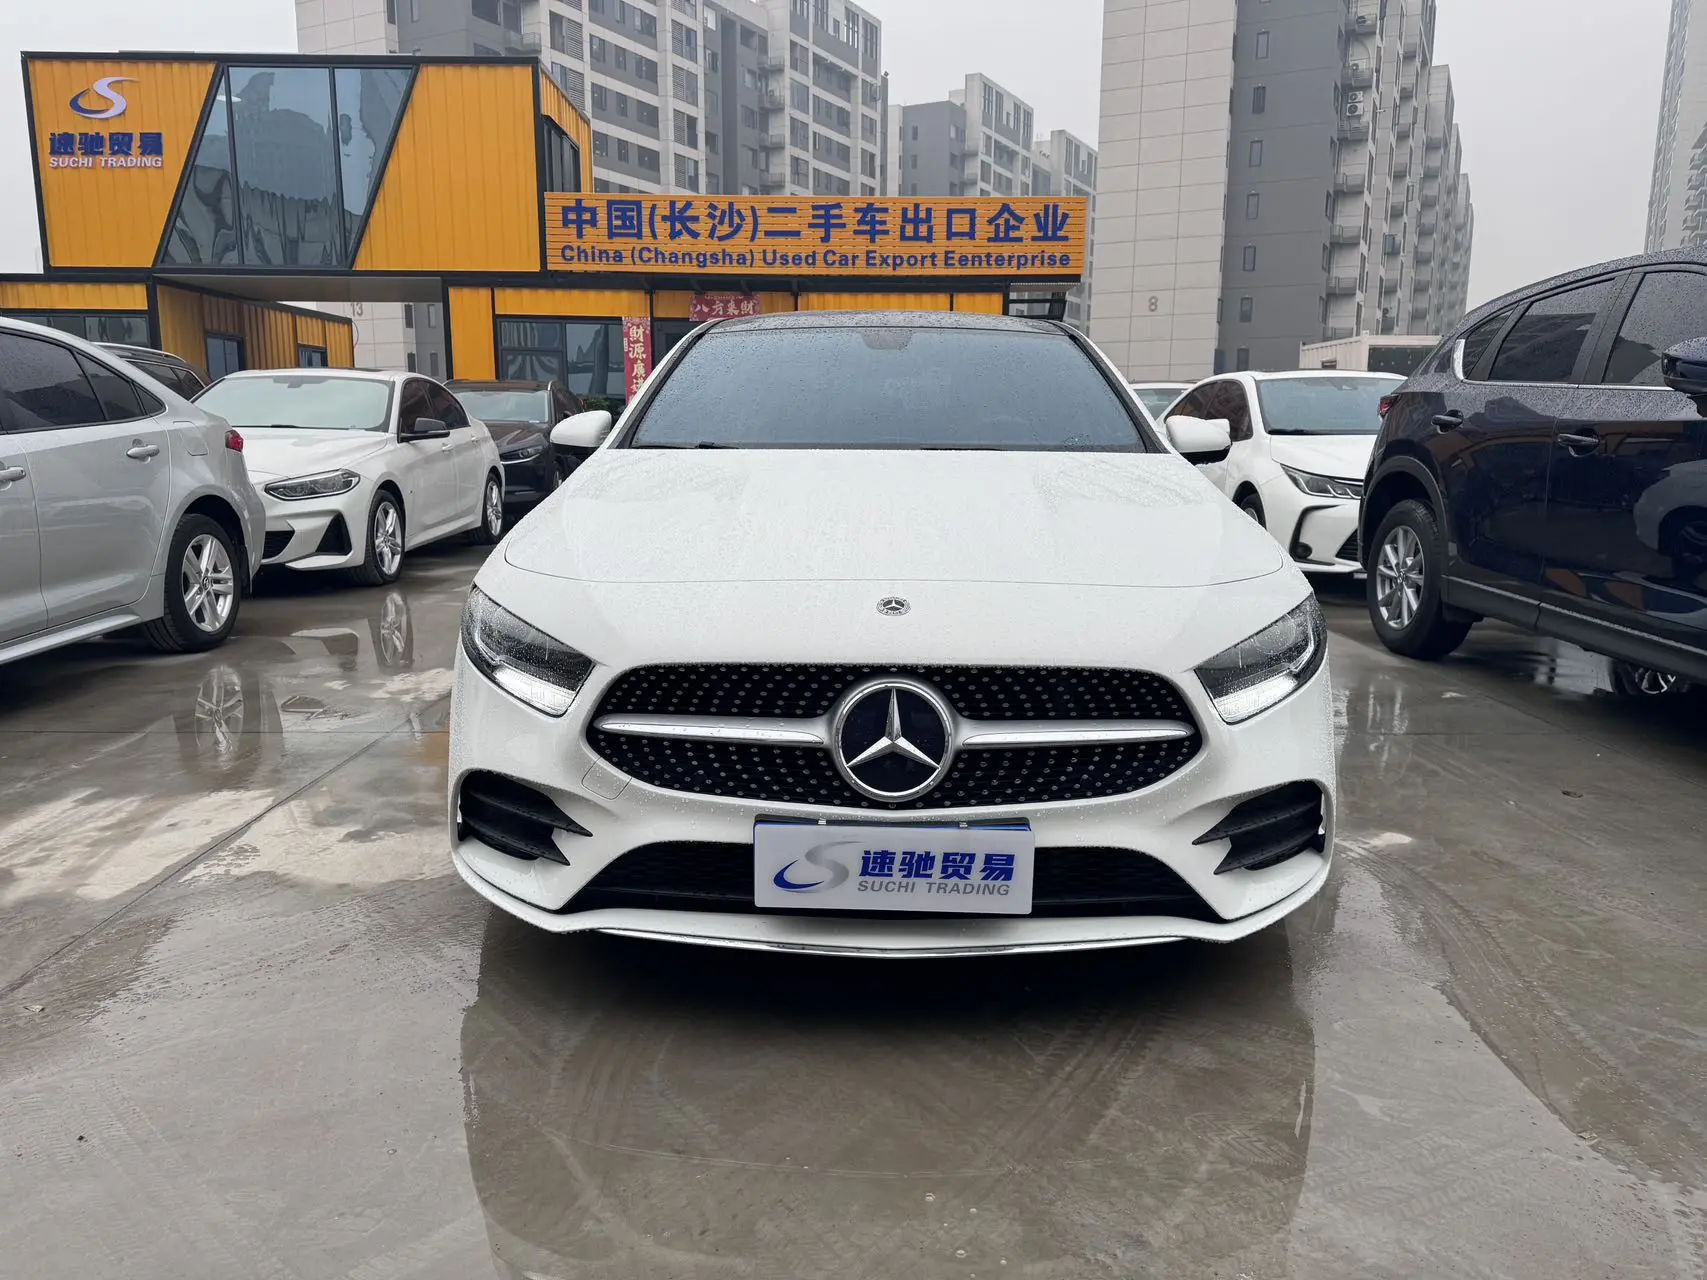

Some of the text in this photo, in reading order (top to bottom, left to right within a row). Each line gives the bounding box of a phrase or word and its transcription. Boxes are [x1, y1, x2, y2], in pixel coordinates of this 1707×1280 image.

[49, 132, 163, 155] 速驰贸易
[49, 157, 162, 168] SUCHI TRADING
[561, 198, 1070, 243] 中国(长沙)二手车出口企业
[561, 245, 1071, 271] China (Changsha) Used Car Export Eenterprise
[1148, 295, 1159, 312] 8
[858, 850, 1015, 882] 速驰贸易
[857, 880, 1010, 896] SUCHI TRADING
